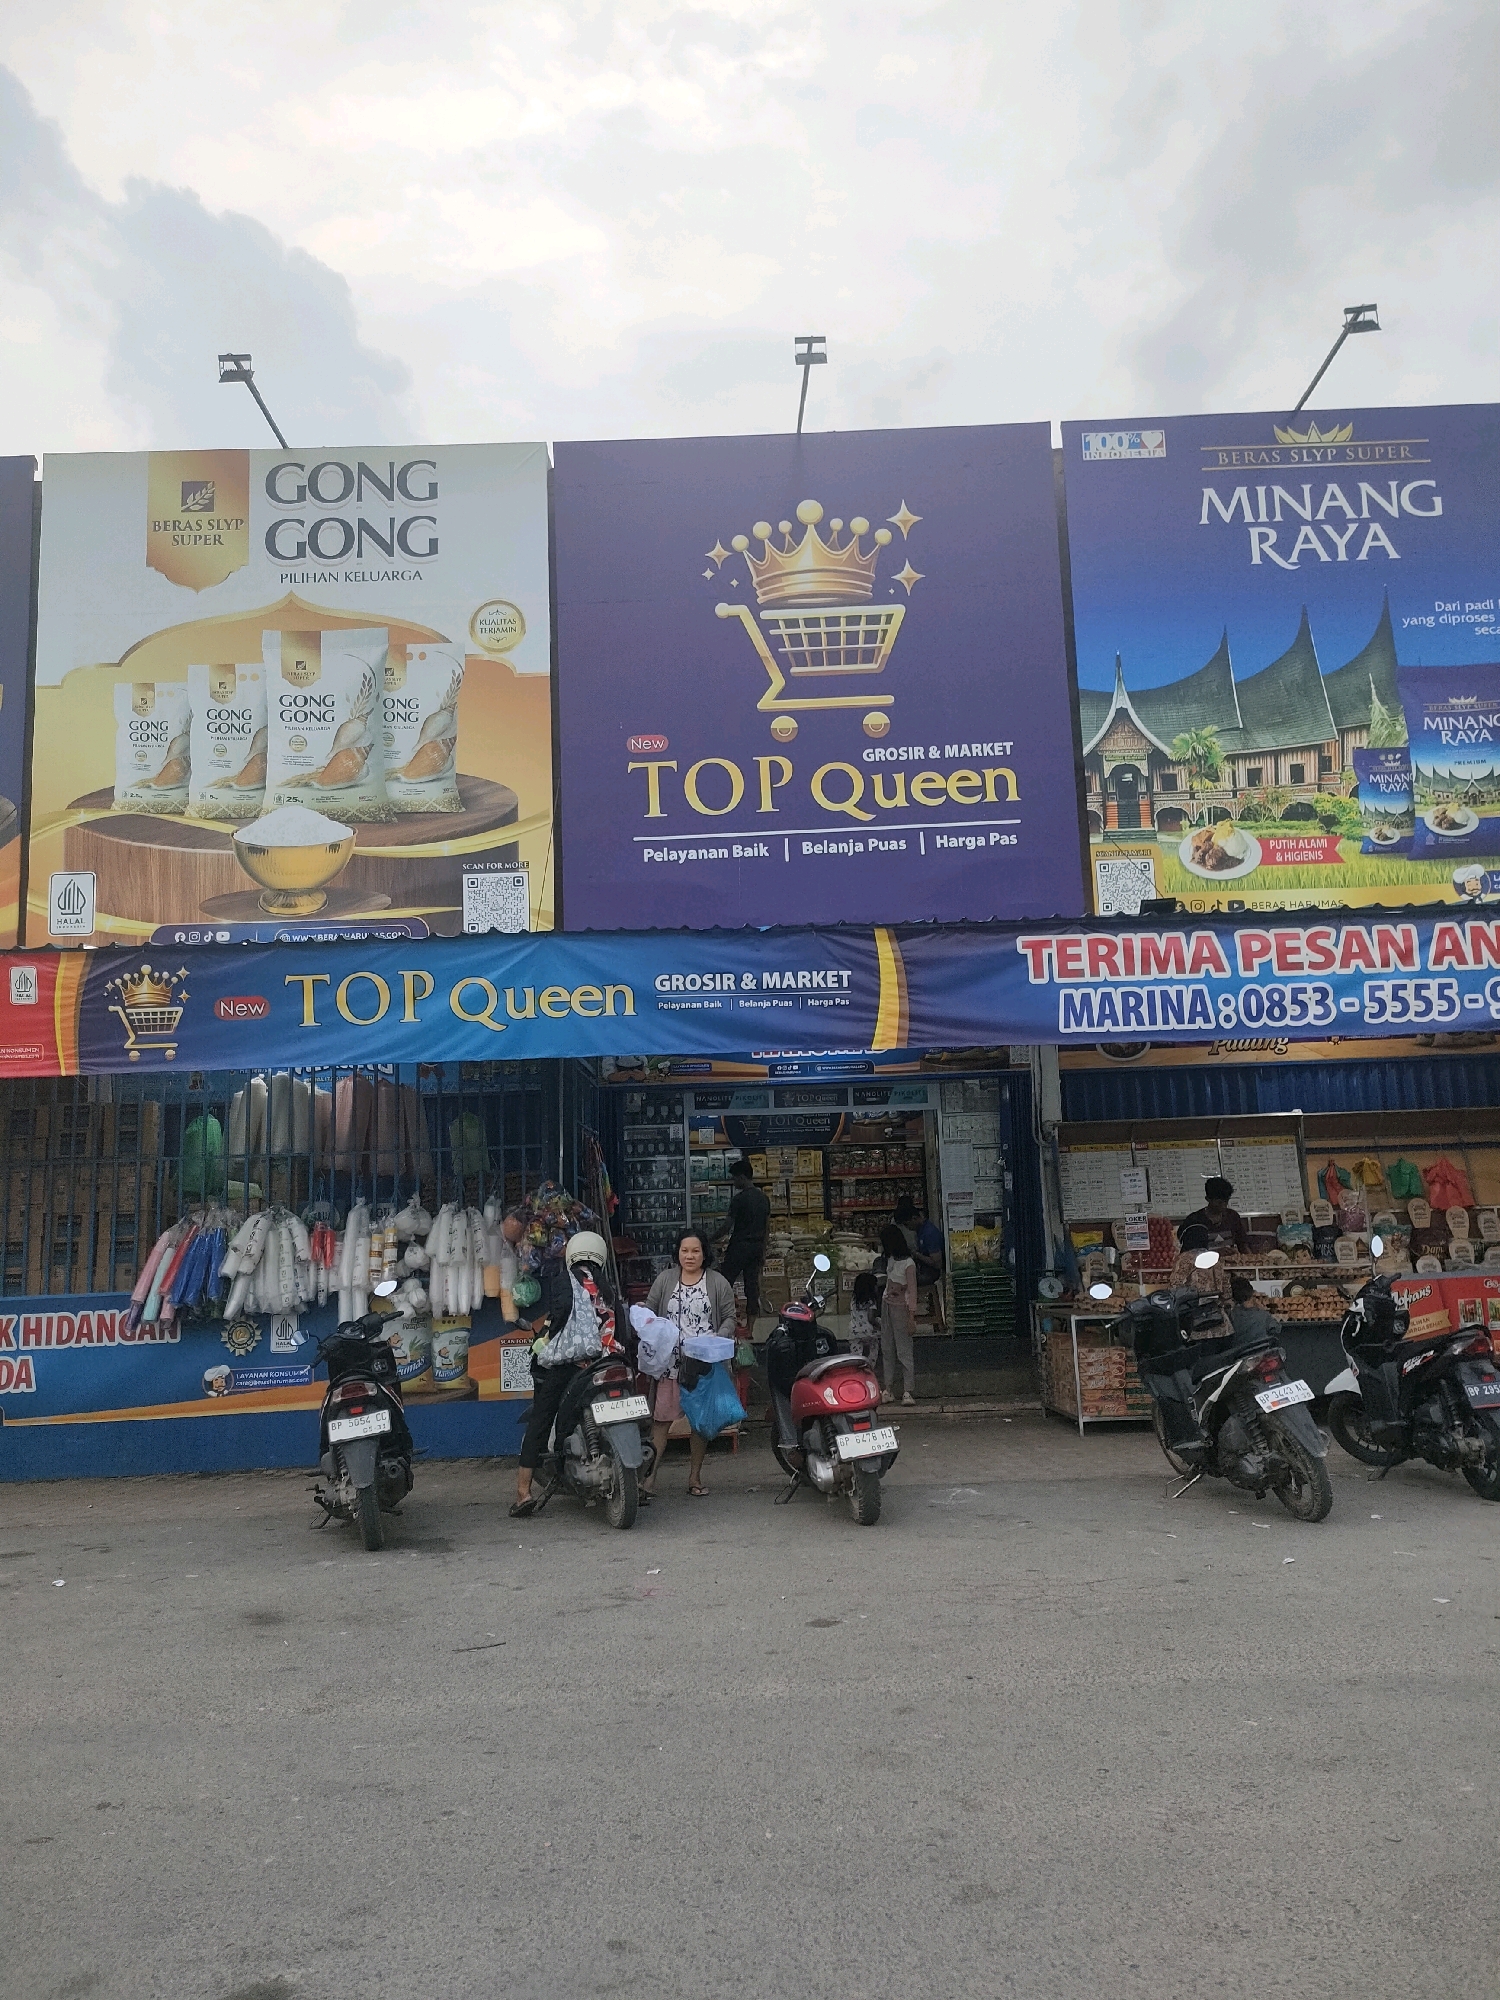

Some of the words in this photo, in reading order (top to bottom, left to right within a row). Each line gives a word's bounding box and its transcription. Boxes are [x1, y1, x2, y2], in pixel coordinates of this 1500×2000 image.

[1218, 449, 1281, 466] BERAS
[1290, 448, 1337, 463] SLYP
[1346, 445, 1414, 460] SUPER
[265, 459, 439, 505] GONG
[1199, 479, 1444, 525] MINANG
[152, 519, 203, 533] BERAS
[207, 518, 245, 531] SLYP
[171, 533, 225, 547] SUPER
[264, 515, 440, 561] GONG
[1248, 522, 1401, 570] RAYA
[279, 571, 339, 584] PILIHAN
[344, 569, 423, 583] KELUARGA
[1434, 600, 1461, 613] Dari
[1465, 599, 1494, 612] padi
[479, 618, 517, 626] KUALITAS
[1402, 615, 1436, 628] yang
[1439, 613, 1496, 627] diproses
[479, 626, 517, 634] TERJAMIN
[278, 694, 336, 708] GONG
[383, 697, 420, 710] ONG
[206, 708, 253, 721] GONG
[278, 709, 336, 723] GONG
[383, 711, 420, 723] ONG
[129, 720, 169, 731] GONG
[206, 722, 252, 735] GONG
[129, 732, 168, 742] GONG
[630, 736, 665, 751] New
[1441, 728, 1493, 747] RAYA
[862, 746, 925, 762] GROSIR
[928, 746, 941, 759] &
[944, 742, 1014, 758] MARKET
[627, 756, 794, 818] TOP
[810, 766, 1022, 822] Queen
[1380, 783, 1409, 793] RAYA
[643, 847, 729, 863] Pelayanan
[732, 843, 770, 858] Baik
[801, 841, 865, 856] Belanja
[868, 838, 908, 852] Puas
[935, 835, 988, 850] Harga
[990, 832, 1019, 846] Pas
[1269, 839, 1296, 850] PUTIH
[1299, 838, 1328, 849] ALAMI
[1275, 853, 1283, 862] &
[1285, 851, 1324, 862] HIGIENIS
[1251, 901, 1286, 910] BERAS
[1017, 935, 1231, 983] TERIMA
[1235, 925, 1420, 978] PESAN
[655, 973, 735, 991] GROSIR
[740, 972, 757, 990] &
[762, 970, 851, 990] MARKET
[284, 969, 435, 1027] TOP
[449, 976, 638, 1031] Queen
[658, 1001, 702, 1010] Pelayanan
[703, 1000, 722, 1008] Baik
[739, 999, 771, 1007] Belanja
[772, 999, 793, 1007] Puas
[807, 998, 833, 1007] Harga
[1059, 984, 1216, 1033] MARINA
[1240, 982, 1336, 1028] 0853
[1364, 978, 1460, 1024] 5555
[218, 1000, 266, 1017] New
[797, 1094, 815, 1102] TOP
[767, 1115, 795, 1126] TOP
[795, 1115, 831, 1128] Queen
[1259, 1394, 1270, 1404] BP
[1272, 1387, 1293, 1399] 3443
[1295, 1383, 1307, 1392] AL
[1468, 1386, 1479, 1396] BP
[1483, 1384, 1500, 1394] 295
[595, 1404, 605, 1413] BP
[634, 1397, 646, 1406] HH
[331, 1421, 342, 1430] BP
[349, 1416, 371, 1427] 5054
[376, 1412, 386, 1421] CC
[855, 1432, 878, 1444] 6478
[881, 1428, 893, 1439] HJ
